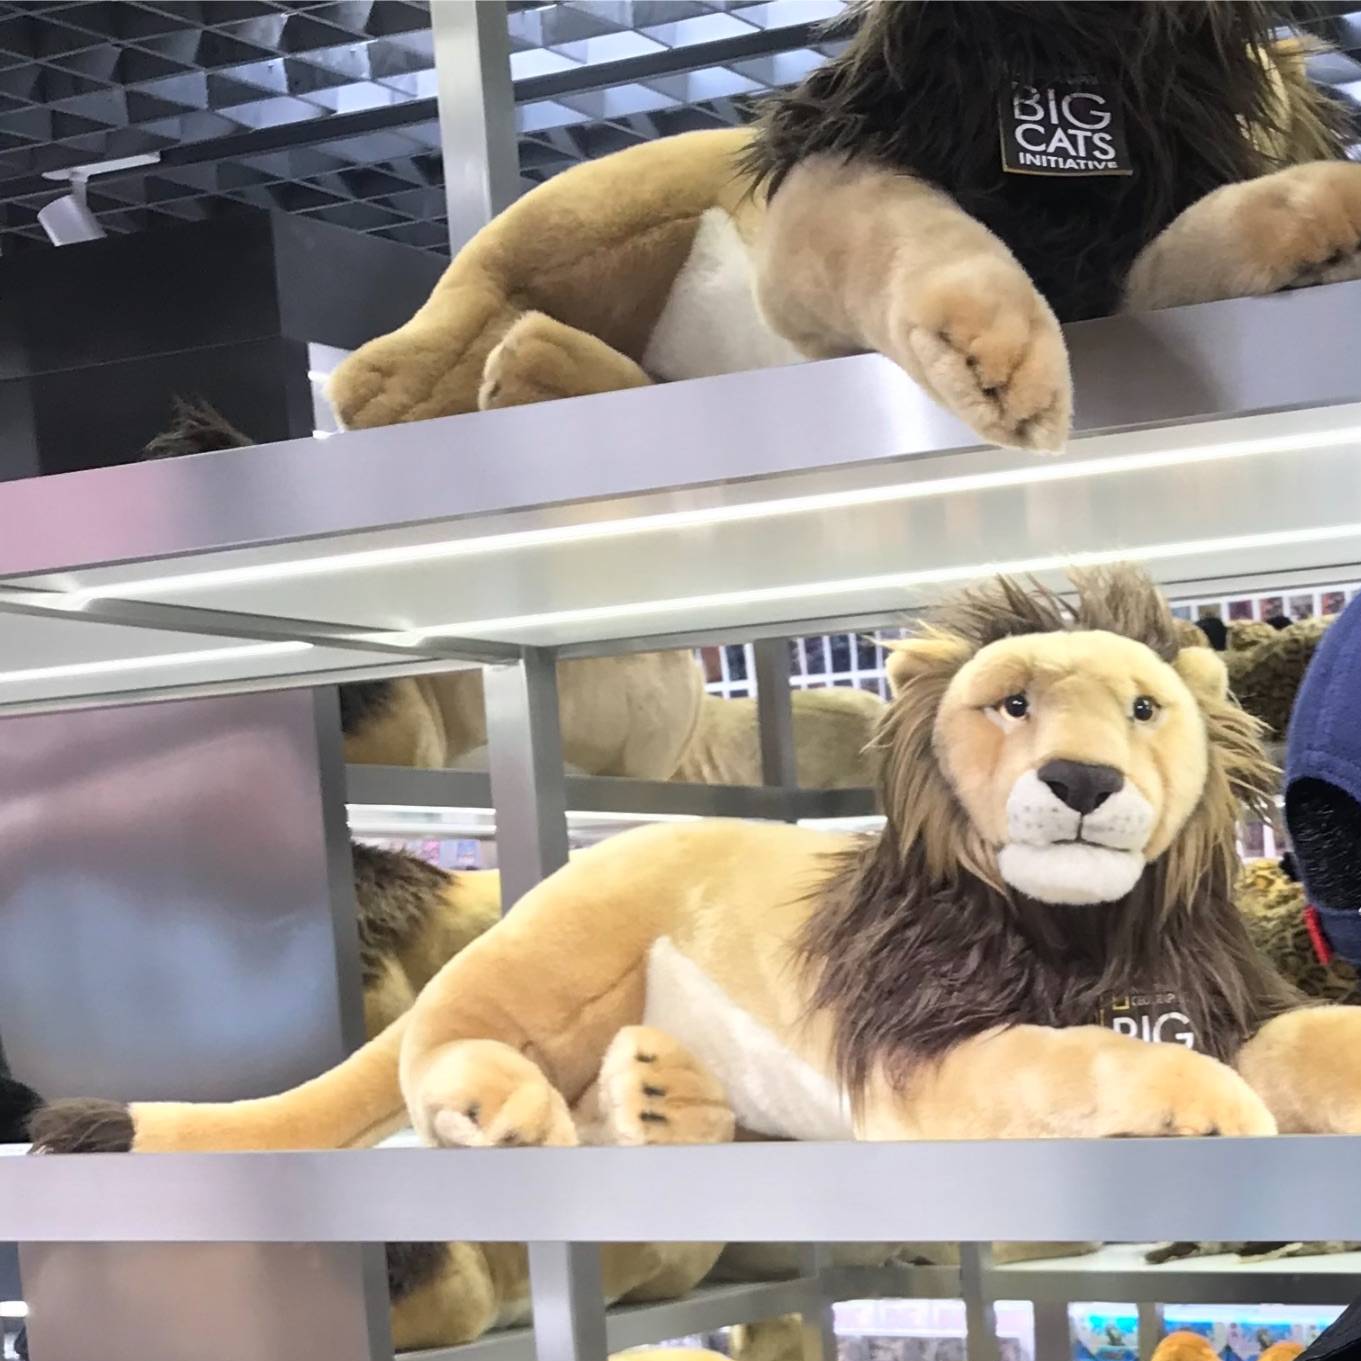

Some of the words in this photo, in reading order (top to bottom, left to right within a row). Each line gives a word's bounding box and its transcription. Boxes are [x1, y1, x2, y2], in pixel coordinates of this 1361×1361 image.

[1013, 83, 1111, 130] BIG
[1015, 123, 1116, 160] CATS
[1018, 152, 1118, 170] INITIATIVE
